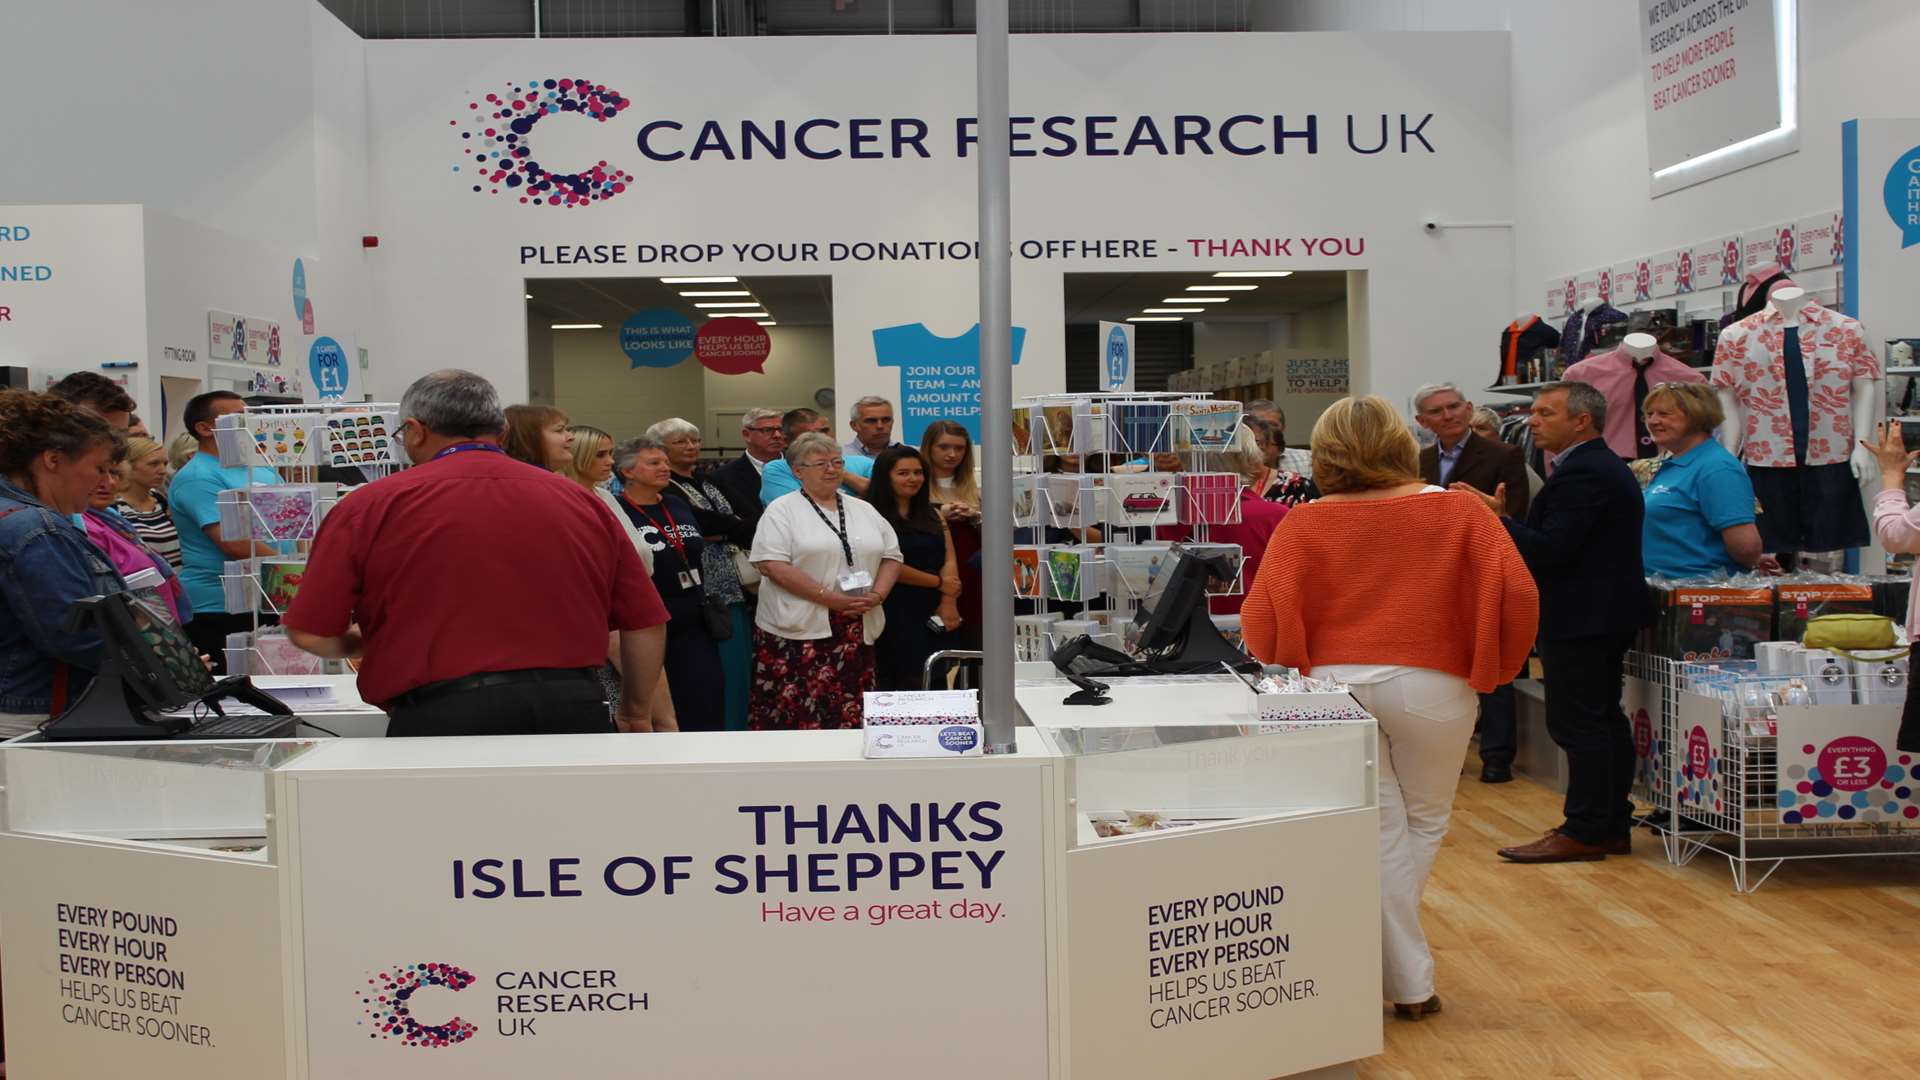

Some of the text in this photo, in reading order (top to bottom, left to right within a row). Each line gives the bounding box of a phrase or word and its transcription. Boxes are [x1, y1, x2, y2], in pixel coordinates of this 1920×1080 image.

[1651, 21, 1685, 54] RESEARCH
[1687, 4, 1717, 36] ACROSS
[1651, 26, 1734, 82] TO HELP MORE PEOPLE
[1653, 58, 1736, 111] BEAT CANCER SOONER
[637, 117, 931, 161] CANCER
[1347, 113, 1435, 154] UK
[1800, 227, 1830, 243] EVERYTHING
[520, 245, 627, 265] PLEASE
[638, 243, 724, 264] DROP
[733, 243, 818, 262] YOUR
[830, 240, 1012, 262] DONATIO
[1187, 238, 1292, 258] THANK
[1301, 237, 1365, 257] YOU
[624, 327, 648, 335] THIS
[662, 326, 691, 334] WHAT
[699, 336, 731, 344] EVERY
[735, 335, 766, 343] HOUR
[624, 340, 693, 350] LOOKS LIKE
[1112, 342, 1124, 356] FOR
[318, 352, 339, 368] FOR
[906, 366, 976, 376] JOIN OUR
[1112, 356, 1124, 380] £1
[320, 367, 344, 391] £1
[906, 379, 945, 390] TEAM
[908, 393, 970, 403] AMOUNT
[908, 407, 940, 416] TIME
[1693, 745, 1705, 765] £3
[1833, 756, 1871, 777] £3
[738, 801, 1004, 846] THANKS
[452, 850, 1006, 899] ISLE OF SHEPPEY
[761, 898, 1006, 926] Have a great day.
[1148, 885, 1284, 926] EVERY POUND
[57, 903, 178, 937] EVERY POUND
[1149, 912, 1273, 952] EVERY HOUR
[58, 928, 168, 962] EVERY HOUR
[1150, 934, 1290, 977] EVERY PERSON
[60, 953, 185, 990] EVERY PERSON
[496, 970, 617, 990] CANCER
[1150, 960, 1286, 1004] HELPS US BEAT
[60, 979, 182, 1016] HELPS US BEAT
[497, 992, 649, 1013] RESEARCH
[1150, 978, 1319, 1029] CANCER SOONER.
[62, 1004, 216, 1048] CANCER SOONER.
[498, 1017, 537, 1037] UK
